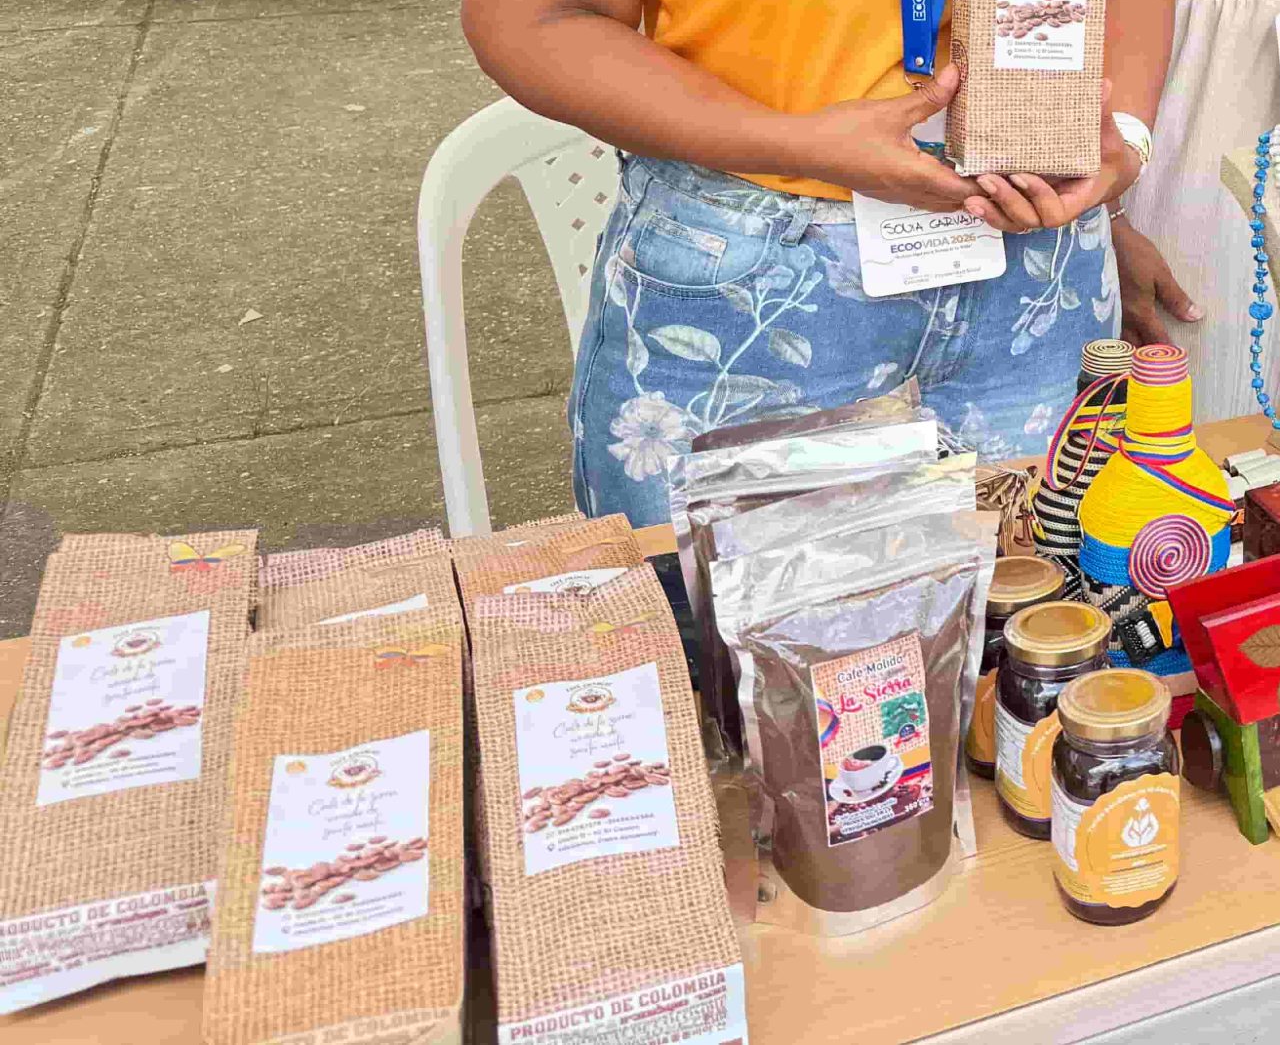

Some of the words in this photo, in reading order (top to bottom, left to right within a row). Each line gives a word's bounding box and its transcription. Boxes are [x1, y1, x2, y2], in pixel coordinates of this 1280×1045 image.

[510, 1005, 604, 1041] PRODUCTO
[611, 998, 634, 1016] DE
[639, 971, 726, 1008] COLOMBIA
